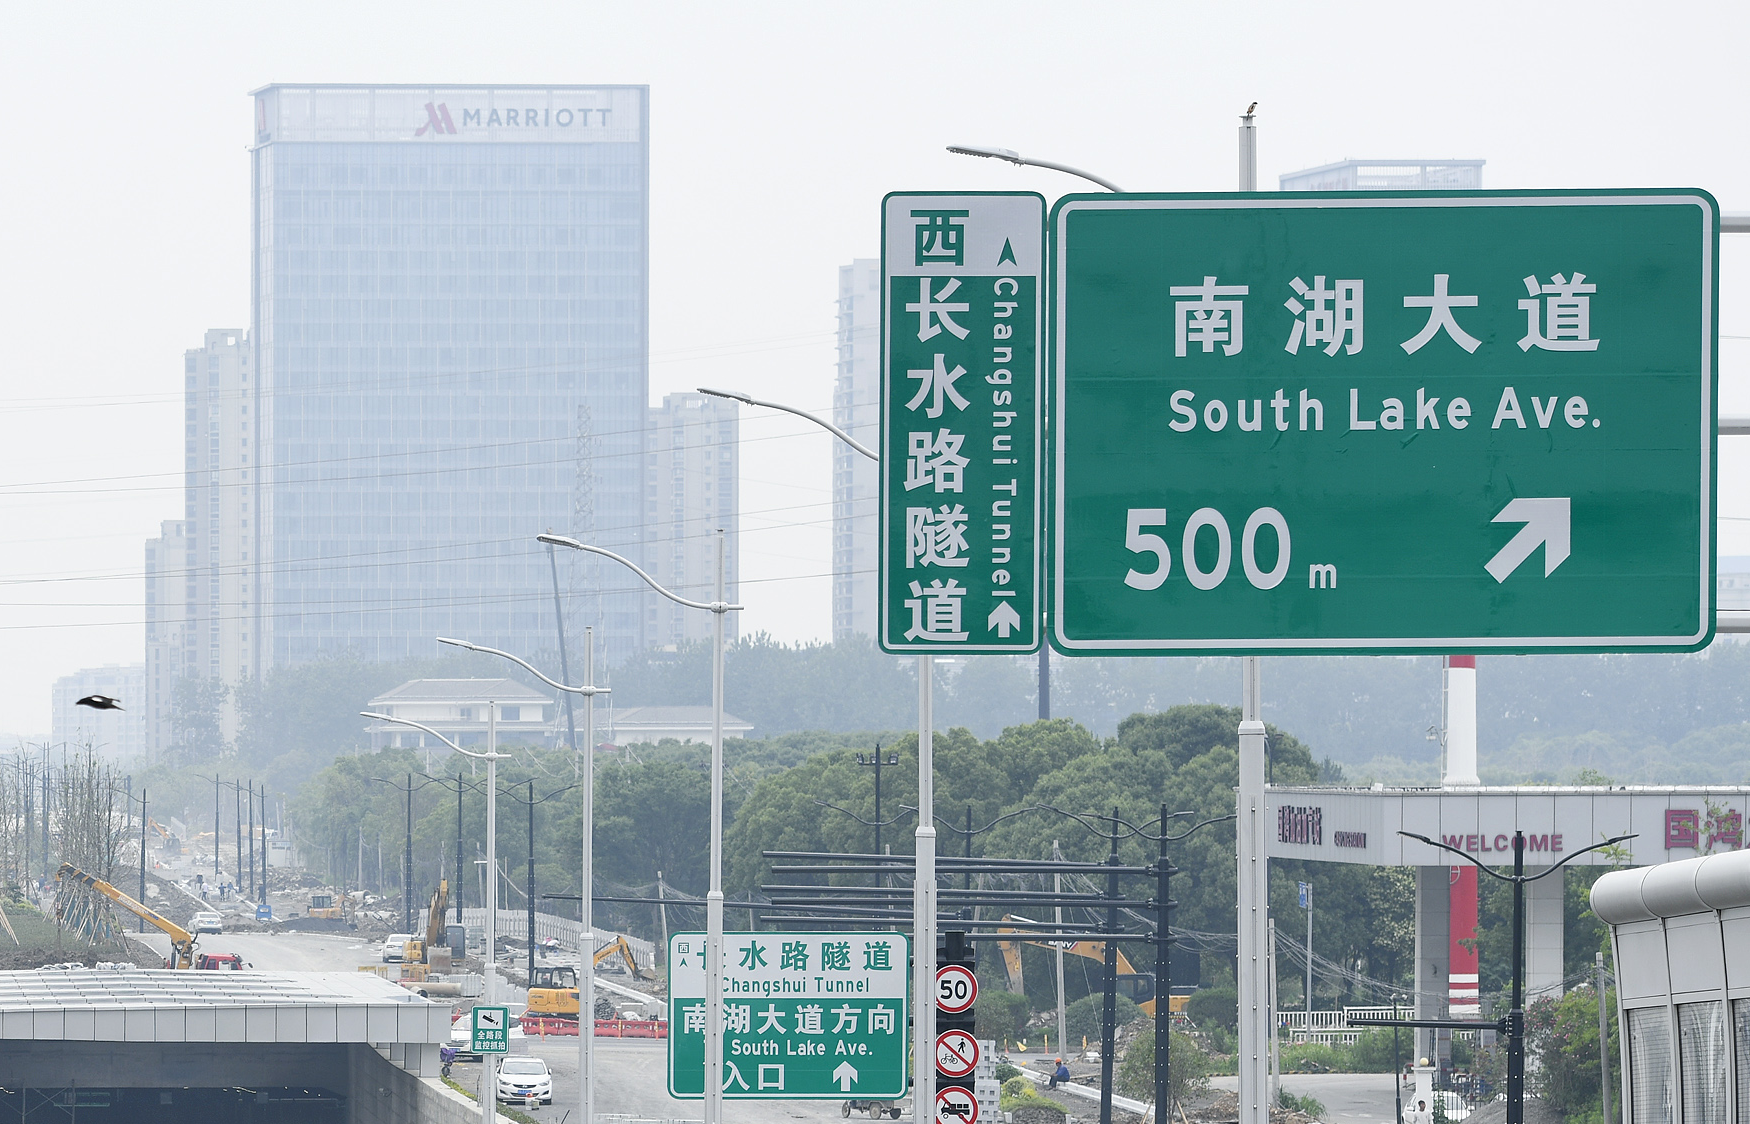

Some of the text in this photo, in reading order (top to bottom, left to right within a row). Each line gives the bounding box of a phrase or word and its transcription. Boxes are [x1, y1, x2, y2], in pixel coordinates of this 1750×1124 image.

[463, 108, 612, 127] MARRIOTT
[910, 209, 970, 267] 西
[1169, 273, 1602, 357] 南湖大道
[1168, 386, 1602, 433] South Lake Ave.
[985, 278, 1018, 597] Changshui Tunnel
[904, 277, 971, 642] 长水路隧道
[814, 977, 870, 993] Tunnel
[940, 980, 968, 1000] 50
[682, 1003, 895, 1035] 南湖大道方向
[474, 1041, 506, 1051] 监控抓拍
[477, 1030, 503, 1040] 全路段
[730, 1039, 873, 1057] South Lake Ave.
